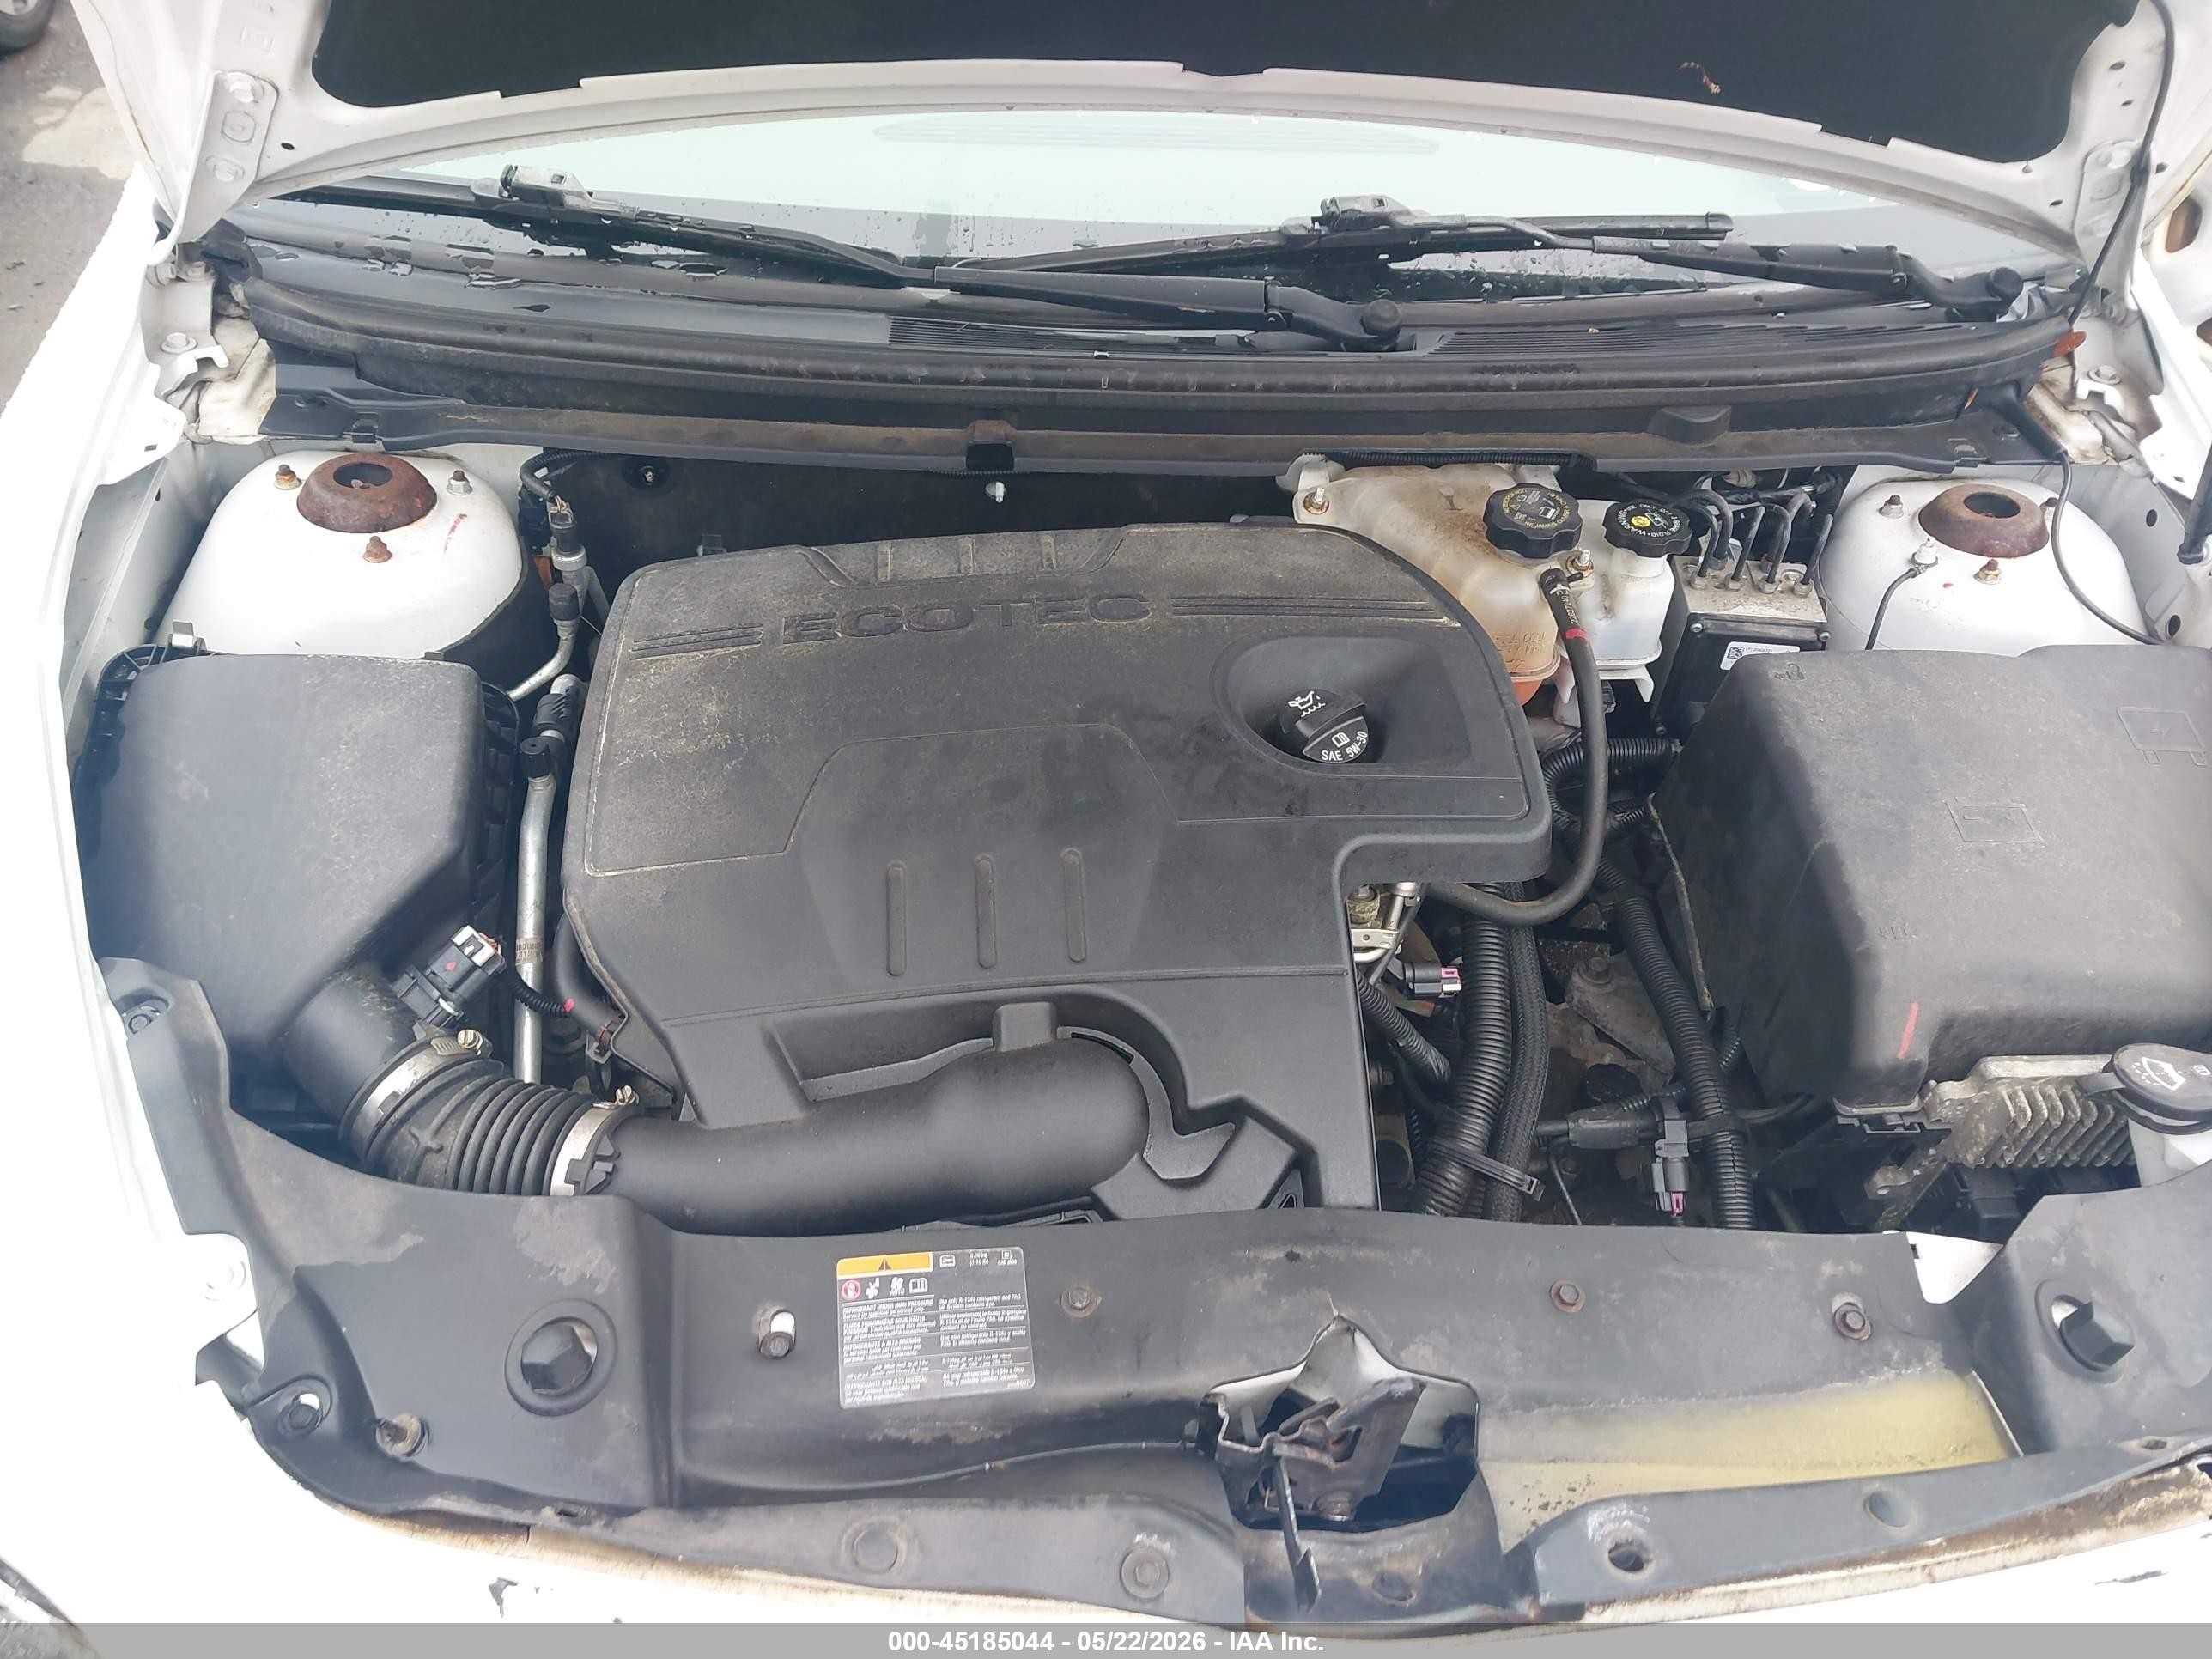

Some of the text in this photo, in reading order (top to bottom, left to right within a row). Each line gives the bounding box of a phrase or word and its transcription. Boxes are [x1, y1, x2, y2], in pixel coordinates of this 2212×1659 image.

[1617, 509, 1647, 537] WARNING
[782, 594, 1152, 645] ECOTEC
[1321, 731, 1368, 762] SAE 5W-30
[890, 1287, 905, 1297] AUTO
